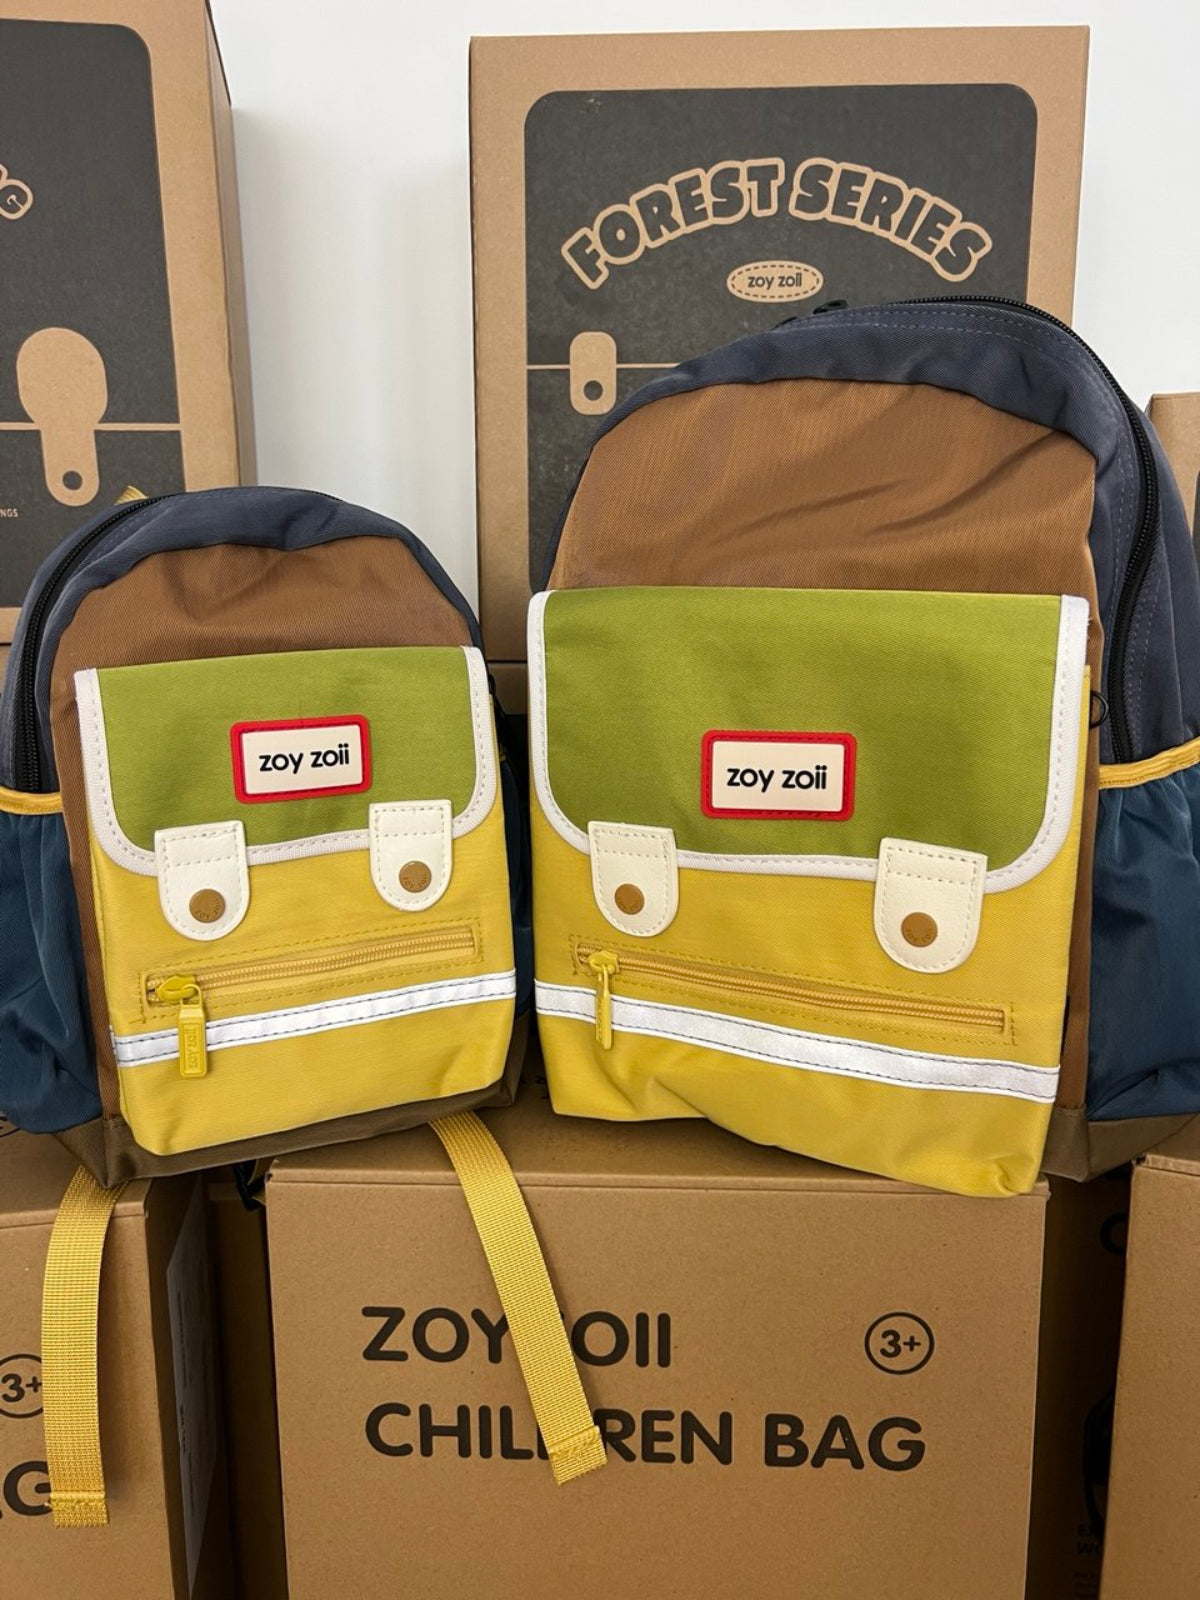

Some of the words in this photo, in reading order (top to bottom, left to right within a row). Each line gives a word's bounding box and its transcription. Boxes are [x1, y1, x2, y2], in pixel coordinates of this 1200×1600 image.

[561, 157, 785, 289] FOREST
[788, 157, 992, 282] SERIES
[748, 276, 775, 291] zoy
[259, 752, 303, 775] zoy
[310, 743, 350, 768] zoii
[727, 768, 774, 793] zoy
[781, 764, 828, 789] zoii
[362, 1306, 509, 1364] ZOY
[561, 1309, 671, 1368] OII
[879, 1329, 922, 1359] 3+
[1, 1373, 42, 1402] 3+
[765, 1413, 926, 1472] BAG
